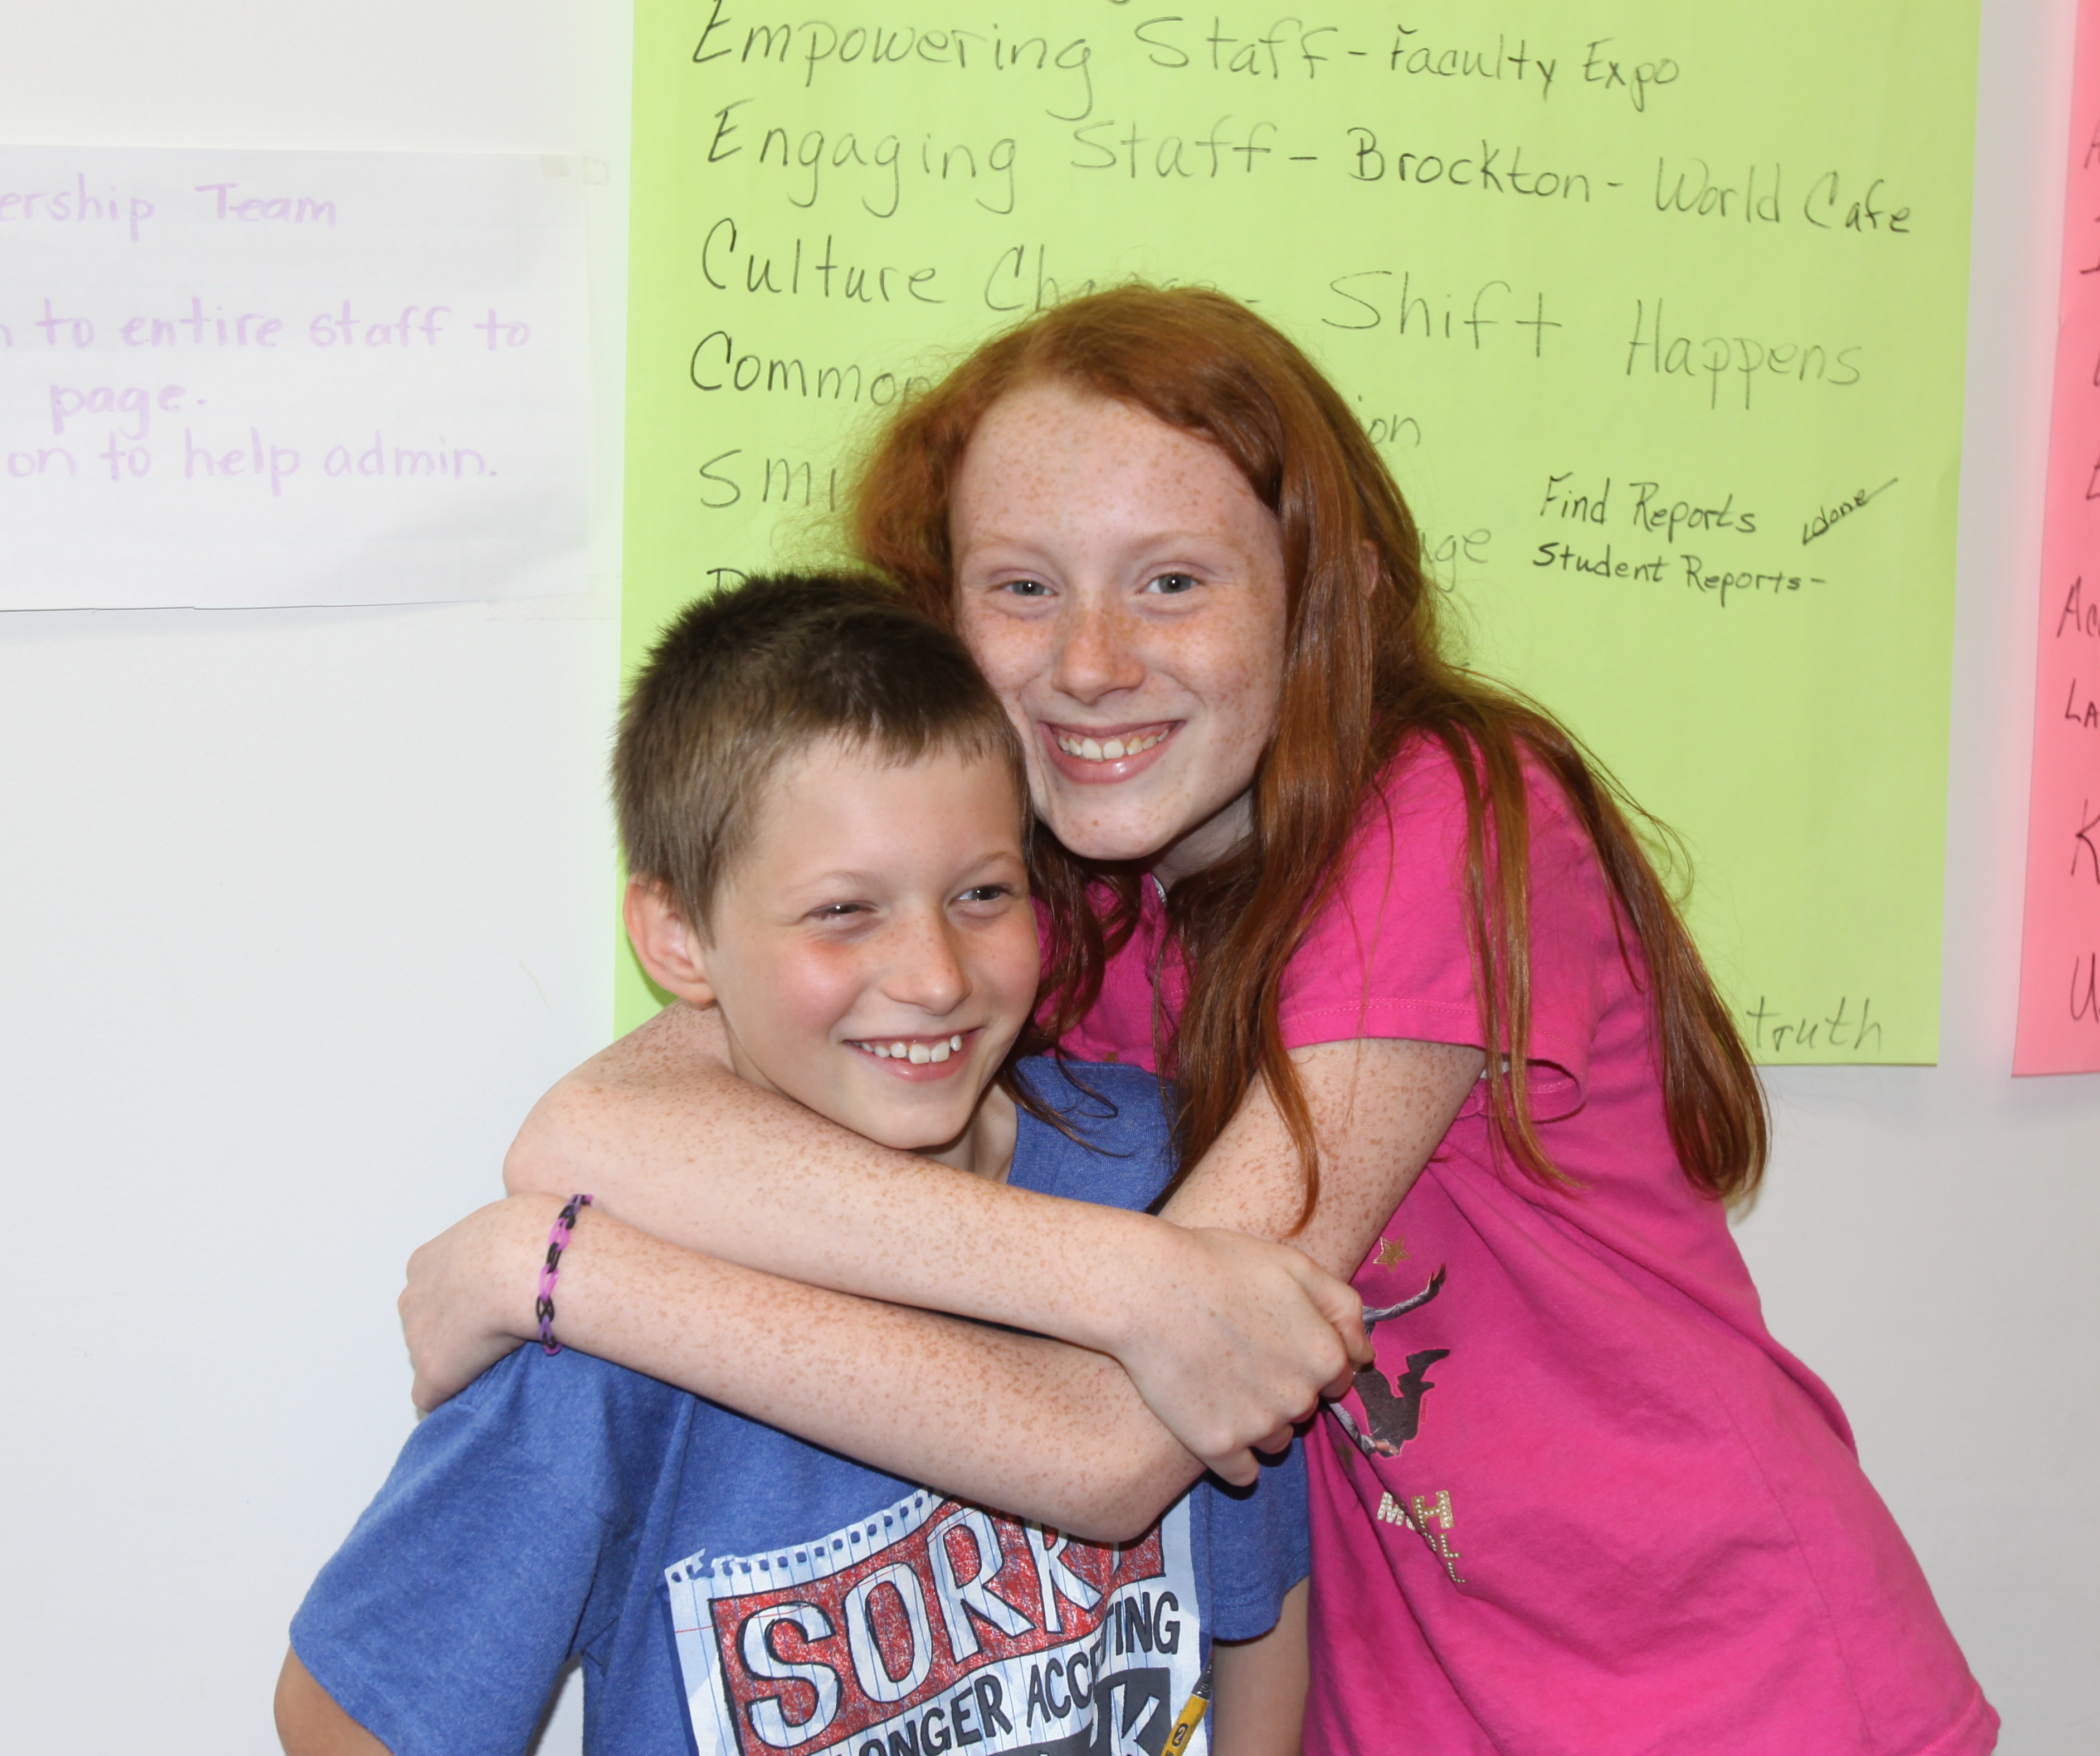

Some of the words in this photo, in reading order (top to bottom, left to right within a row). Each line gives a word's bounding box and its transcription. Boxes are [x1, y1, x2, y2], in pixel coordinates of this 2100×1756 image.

[691, 0, 1093, 124] Empowering
[1133, 15, 1339, 80] Staff
[1390, 23, 1557, 103] Faculty
[1581, 37, 1680, 114] Expo
[707, 98, 1016, 221] Engaging
[1066, 108, 1278, 179] Staff
[1346, 127, 1590, 203] Brockton
[1655, 156, 1781, 224] World
[1802, 169, 1911, 234] Cafe
[193, 182, 337, 230] Team
[33, 296, 96, 349] to
[118, 294, 284, 348] entire
[308, 299, 454, 349] staff
[472, 308, 532, 353] to
[701, 214, 946, 304] Culture
[1321, 270, 1563, 358] Shift
[1625, 297, 1862, 411] Happens
[98, 429, 152, 481] to
[183, 426, 301, 499] help
[1539, 471, 1611, 526] Find
[1628, 481, 1757, 544] Reports
[1532, 541, 1670, 583] Student
[1742, 994, 1882, 1057] truth
[734, 1506, 1122, 1751] SORR
[834, 1674, 1013, 1756] NGER
[1026, 1591, 1181, 1728] ACCTING
